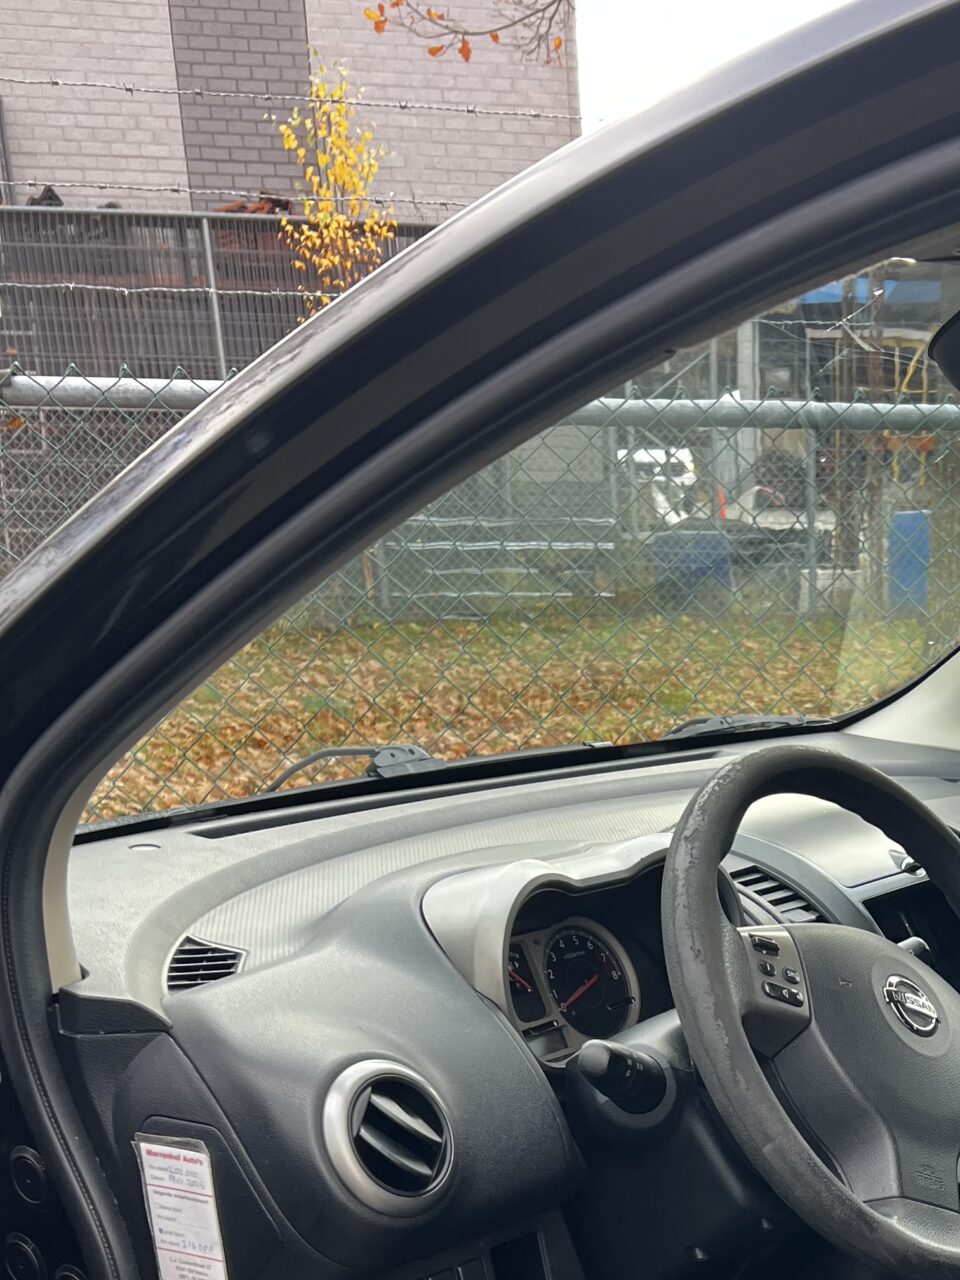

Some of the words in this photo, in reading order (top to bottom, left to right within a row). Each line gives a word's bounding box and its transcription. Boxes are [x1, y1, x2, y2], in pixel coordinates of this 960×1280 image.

[559, 939, 566, 950] 4
[572, 935, 580, 947] 5
[587, 940, 594, 951] 6
[550, 951, 557, 963] 3
[600, 952, 606, 963] 7
[547, 969, 556, 980] 2
[611, 970, 619, 981] 8
[552, 988, 559, 1000] 1
